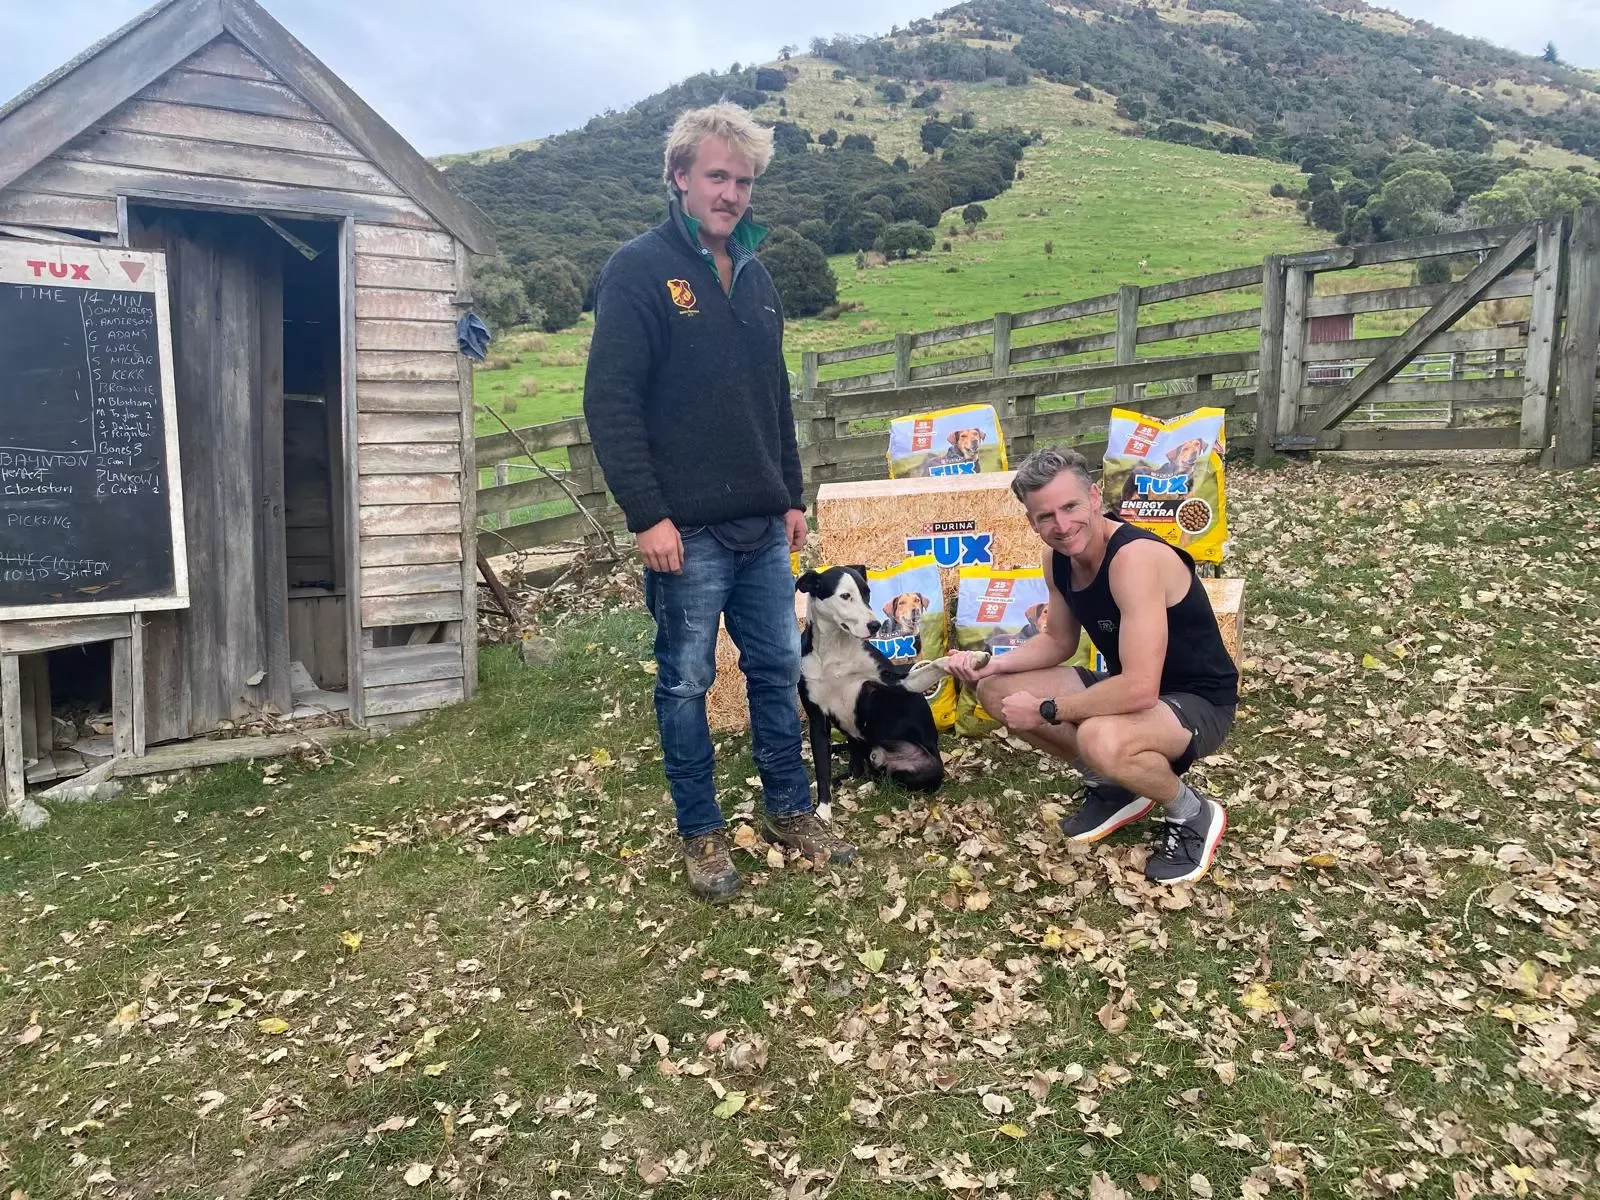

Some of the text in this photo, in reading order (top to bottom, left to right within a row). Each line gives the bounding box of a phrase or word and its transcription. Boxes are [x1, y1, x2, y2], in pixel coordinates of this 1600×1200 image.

[27, 260, 91, 281] TUX
[14, 286, 66, 303] TIME
[110, 293, 142, 307] MIN
[100, 317, 153, 327] ANDERSON
[108, 329, 148, 342] ADAMS
[92, 356, 101, 366] S
[93, 368, 145, 381] S KERR
[145, 411, 153, 419] 2
[133, 442, 143, 457] 3
[1136, 475, 1189, 495] TUX
[1121, 500, 1164, 509] ENERGY
[1138, 508, 1174, 517] EXTRA
[934, 521, 973, 531] PURINA
[906, 534, 992, 567] TUX
